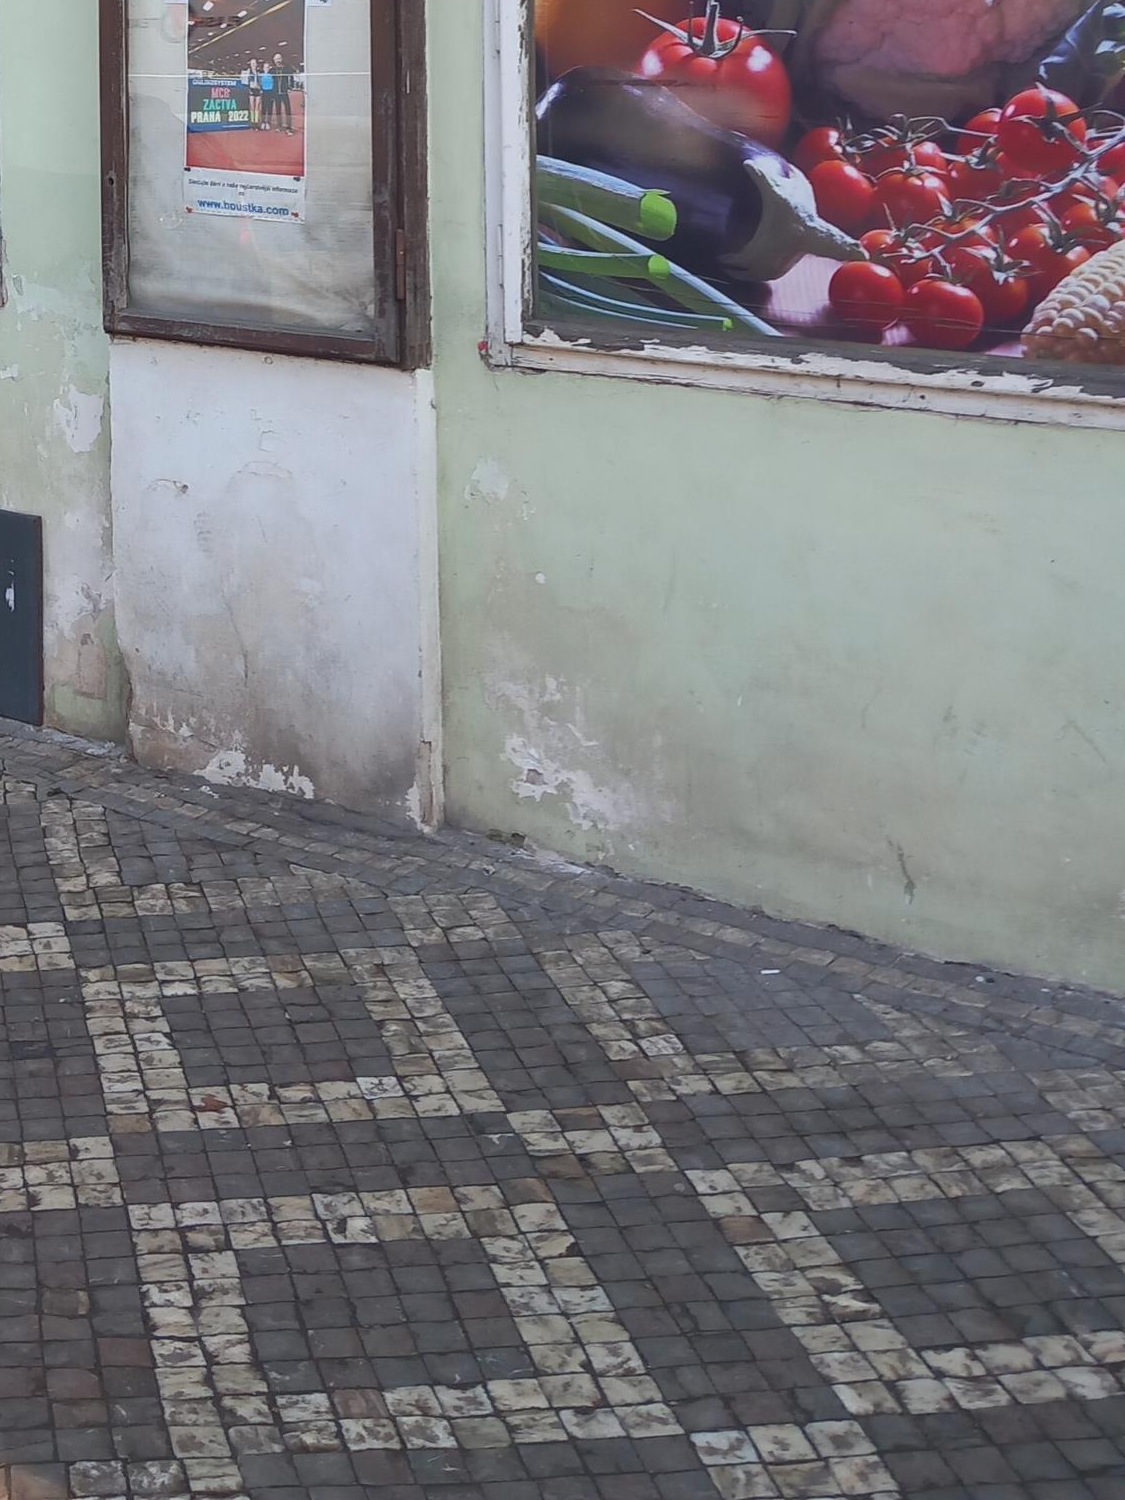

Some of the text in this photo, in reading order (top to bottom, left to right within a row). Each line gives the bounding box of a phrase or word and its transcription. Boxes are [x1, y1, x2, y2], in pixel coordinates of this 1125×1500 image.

[190, 110, 249, 123] PRAHA 2022
[197, 199, 290, 216] www.houstka.com
